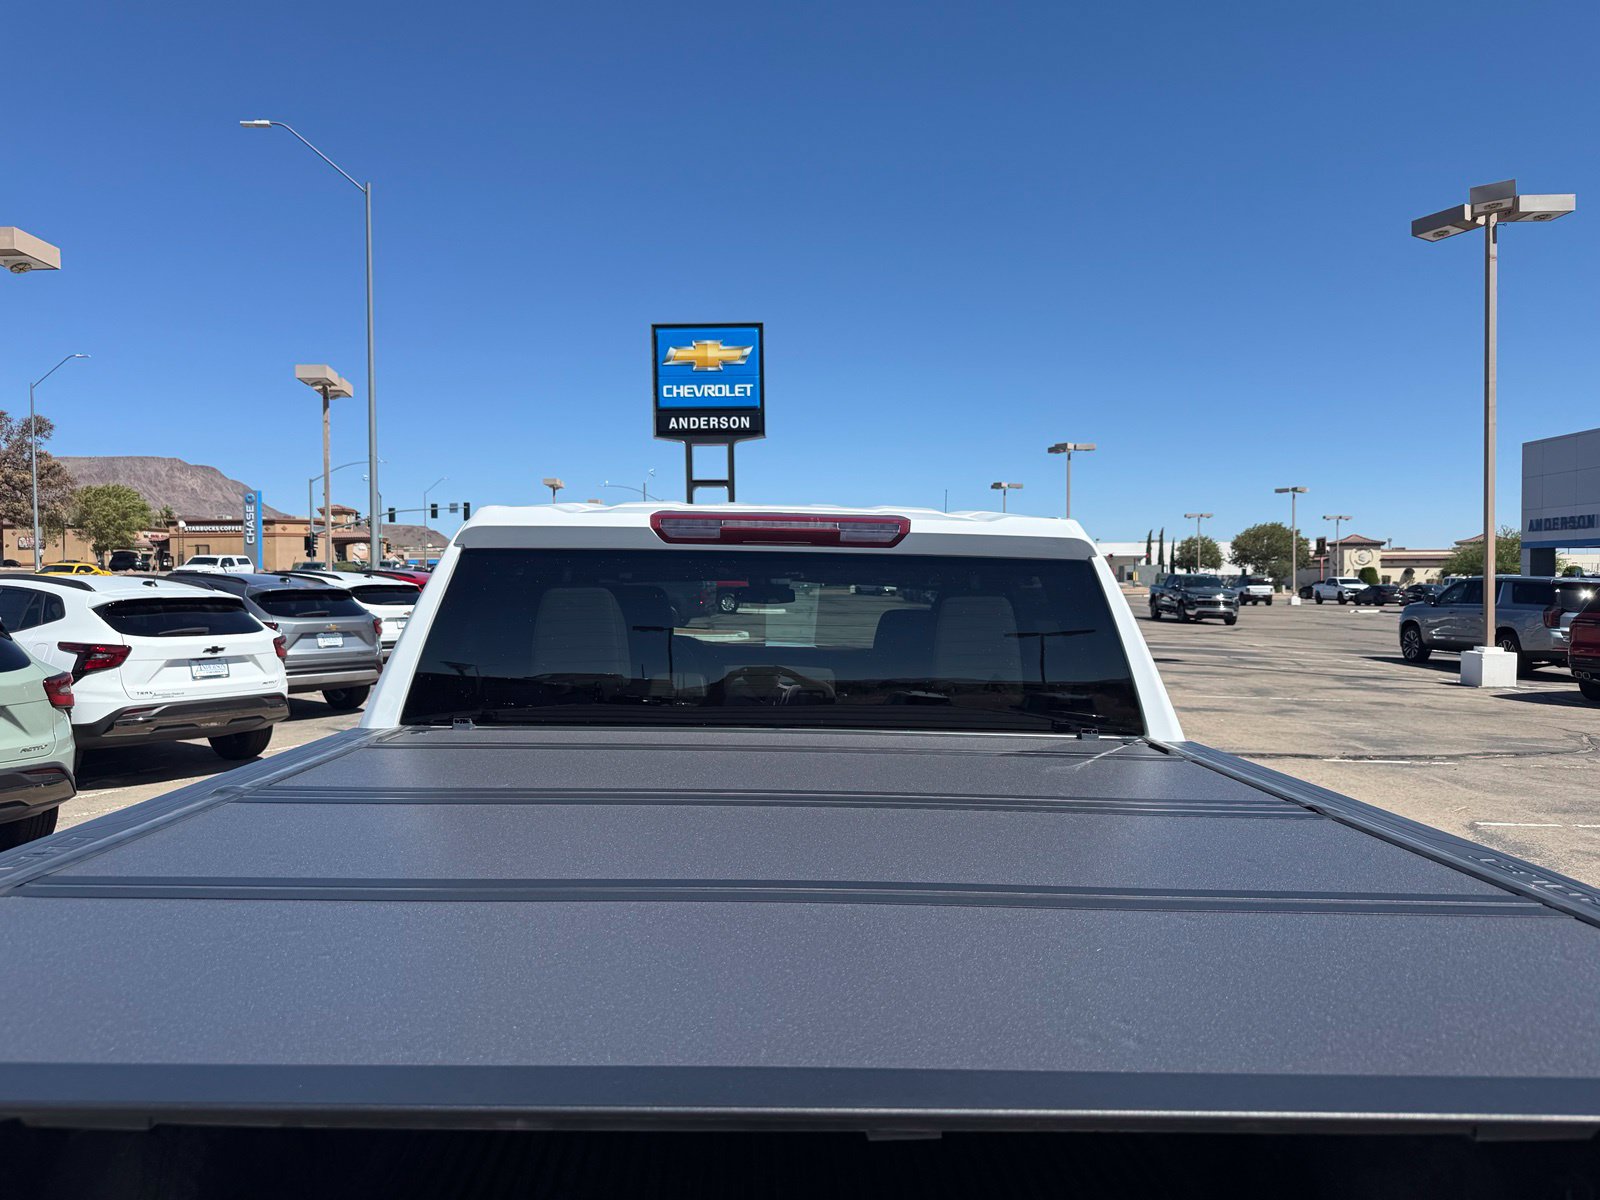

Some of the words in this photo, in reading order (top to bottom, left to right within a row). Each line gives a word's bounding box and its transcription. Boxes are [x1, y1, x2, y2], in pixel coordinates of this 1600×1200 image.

[662, 384, 754, 398] CHEVROLET
[668, 416, 750, 429] ANDERSON
[246, 505, 255, 544] CHASE
[1528, 514, 1596, 532] ANDERSON
